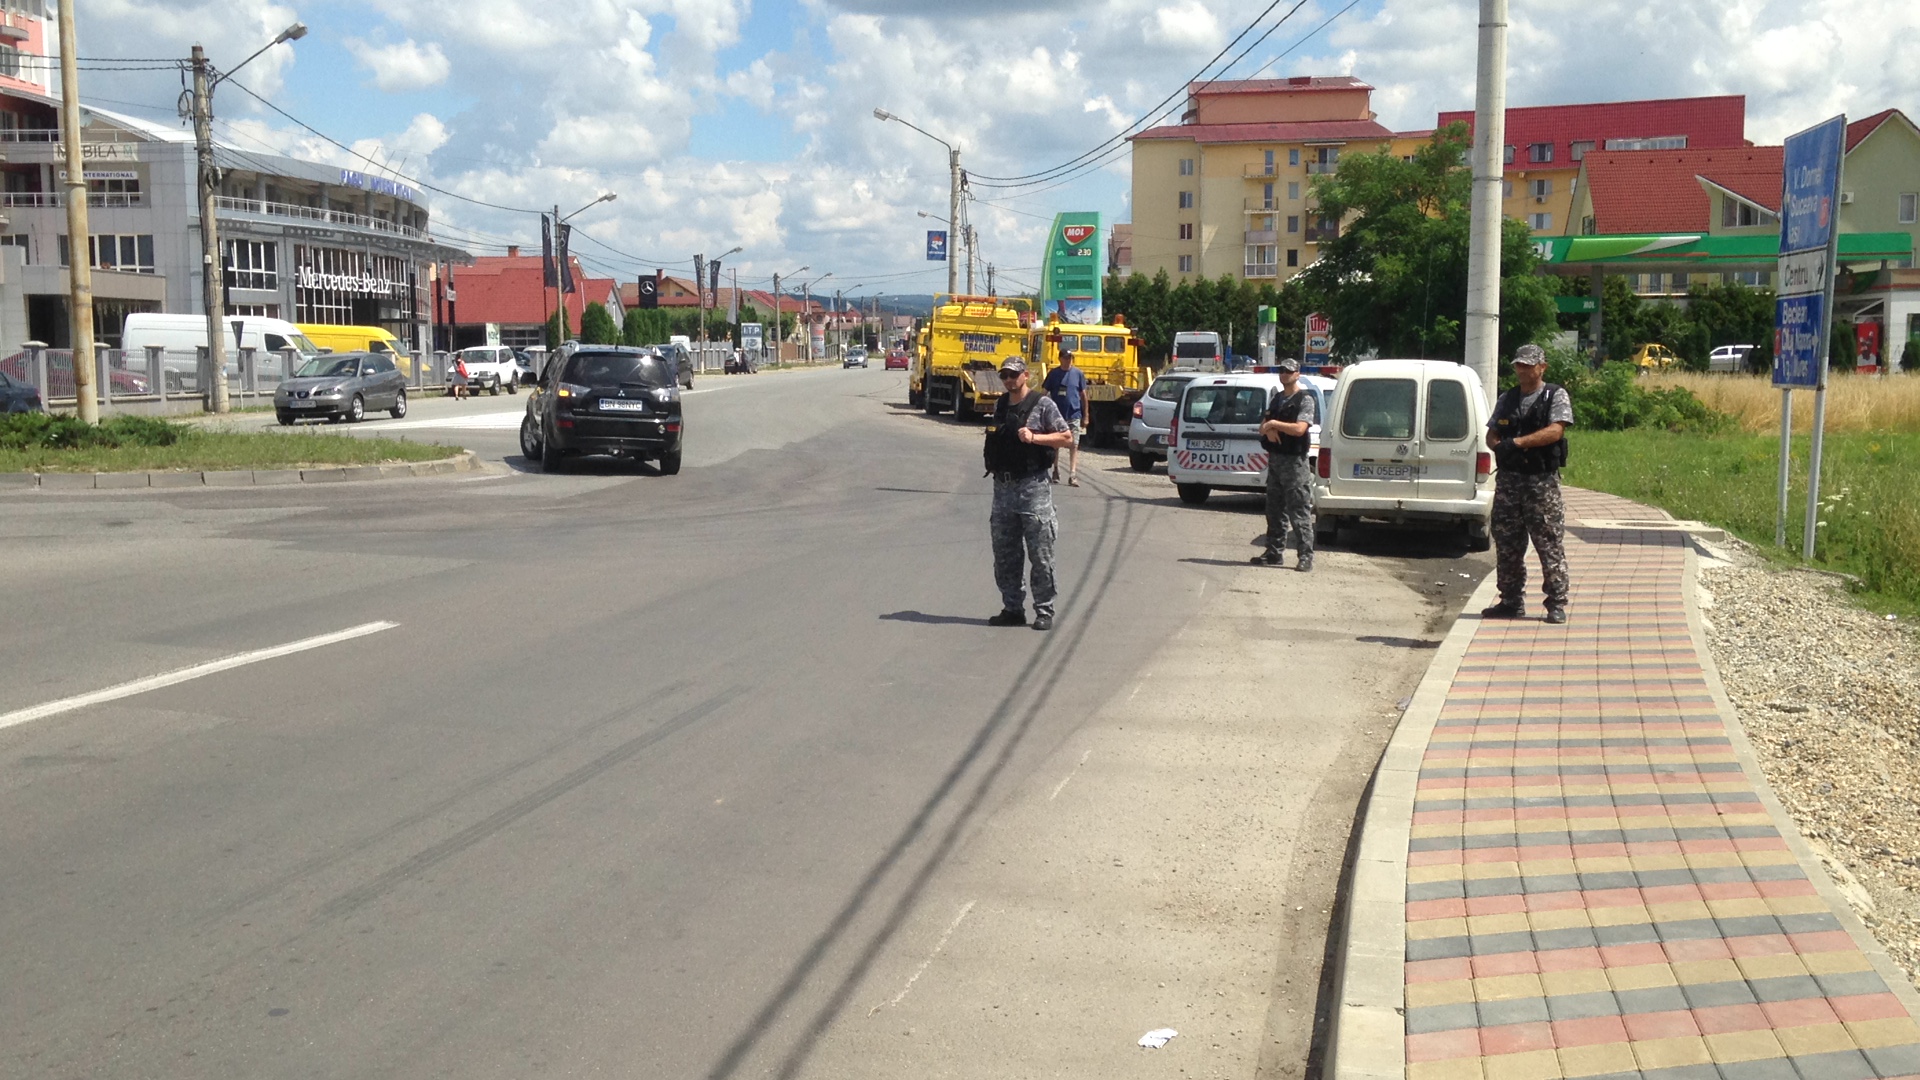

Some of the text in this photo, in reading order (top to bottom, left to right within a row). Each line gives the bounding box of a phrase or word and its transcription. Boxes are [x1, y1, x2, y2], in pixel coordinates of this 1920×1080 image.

[57, 145, 118, 158] MBILA
[1067, 228, 1085, 236] MOL
[297, 266, 390, 294] Mercedes-Benz
[1784, 264, 1809, 287] Centru
[964, 343, 995, 353] CRACIUN
[1360, 466, 1374, 475] BN
[1376, 467, 1409, 476] 05EBP
